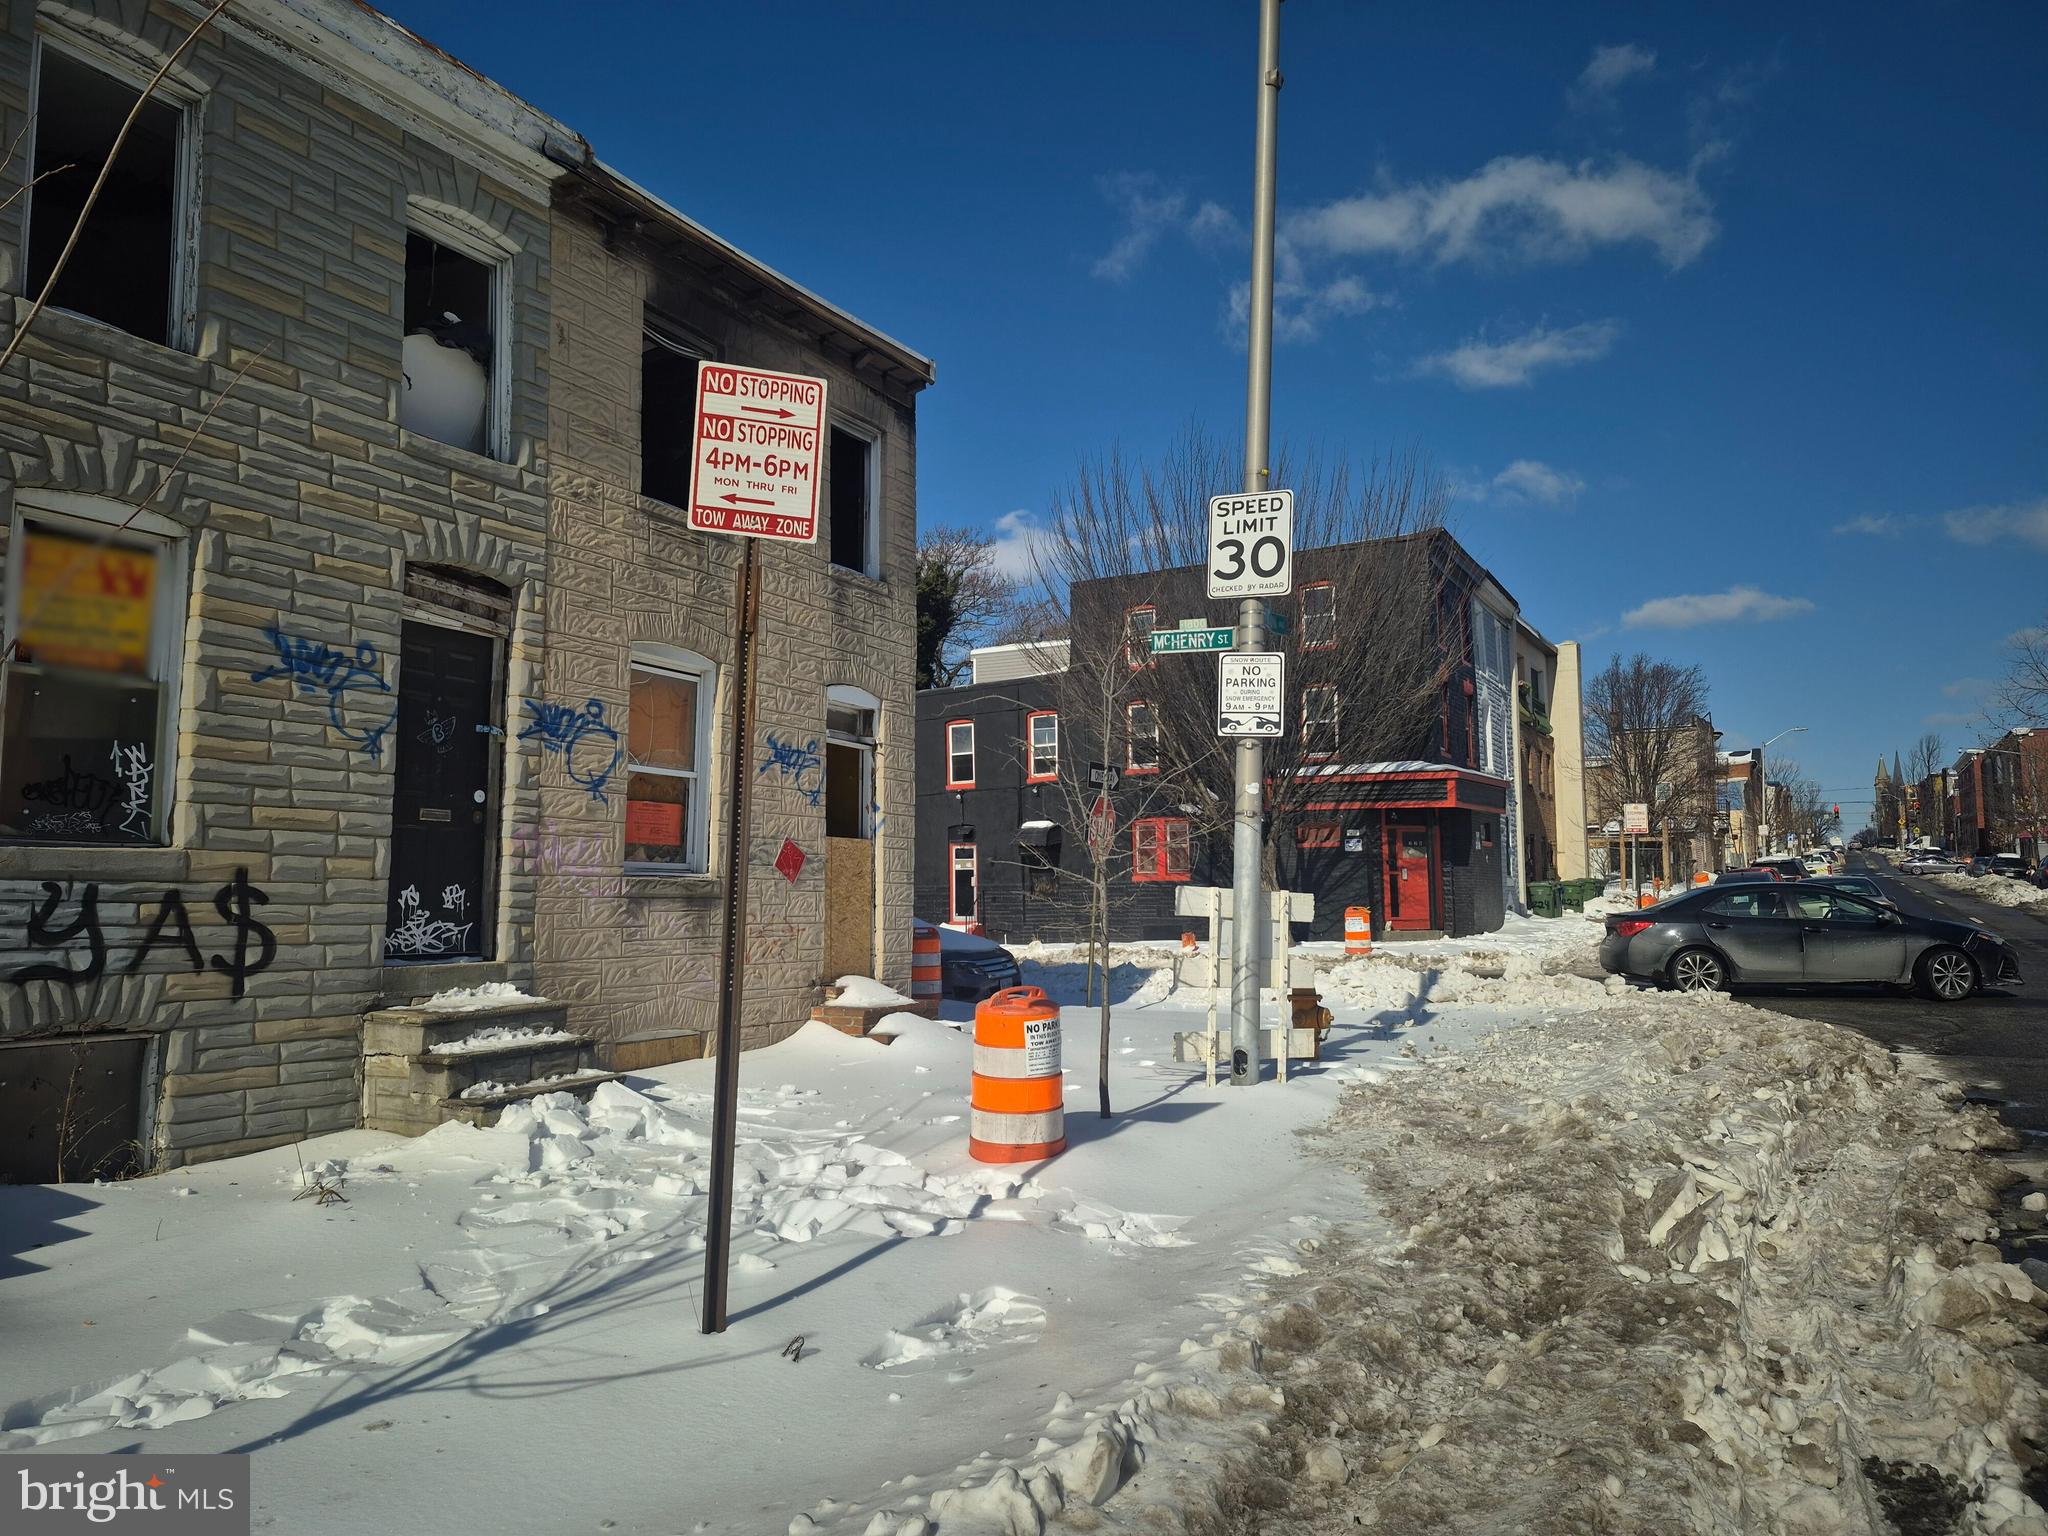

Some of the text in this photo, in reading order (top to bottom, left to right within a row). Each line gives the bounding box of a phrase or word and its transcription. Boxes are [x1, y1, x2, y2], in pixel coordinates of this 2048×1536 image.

[706, 371, 815, 405] NO STOPPING
[702, 417, 812, 451] NO STOPPING
[706, 447, 808, 480] 4PM-6PM
[714, 477, 797, 494] MON THRU FRI
[1217, 497, 1283, 518] SPEED
[696, 508, 810, 536] TOW AWAY ZONE
[1224, 517, 1277, 535] LIMIT
[1213, 536, 1285, 580] 30
[1212, 584, 1243, 593] CHECKED
[1259, 582, 1284, 590] RADAR
[1242, 666, 1261, 675] NO
[1226, 678, 1276, 687] PARKING
[1026, 1024, 1040, 1033] NO
